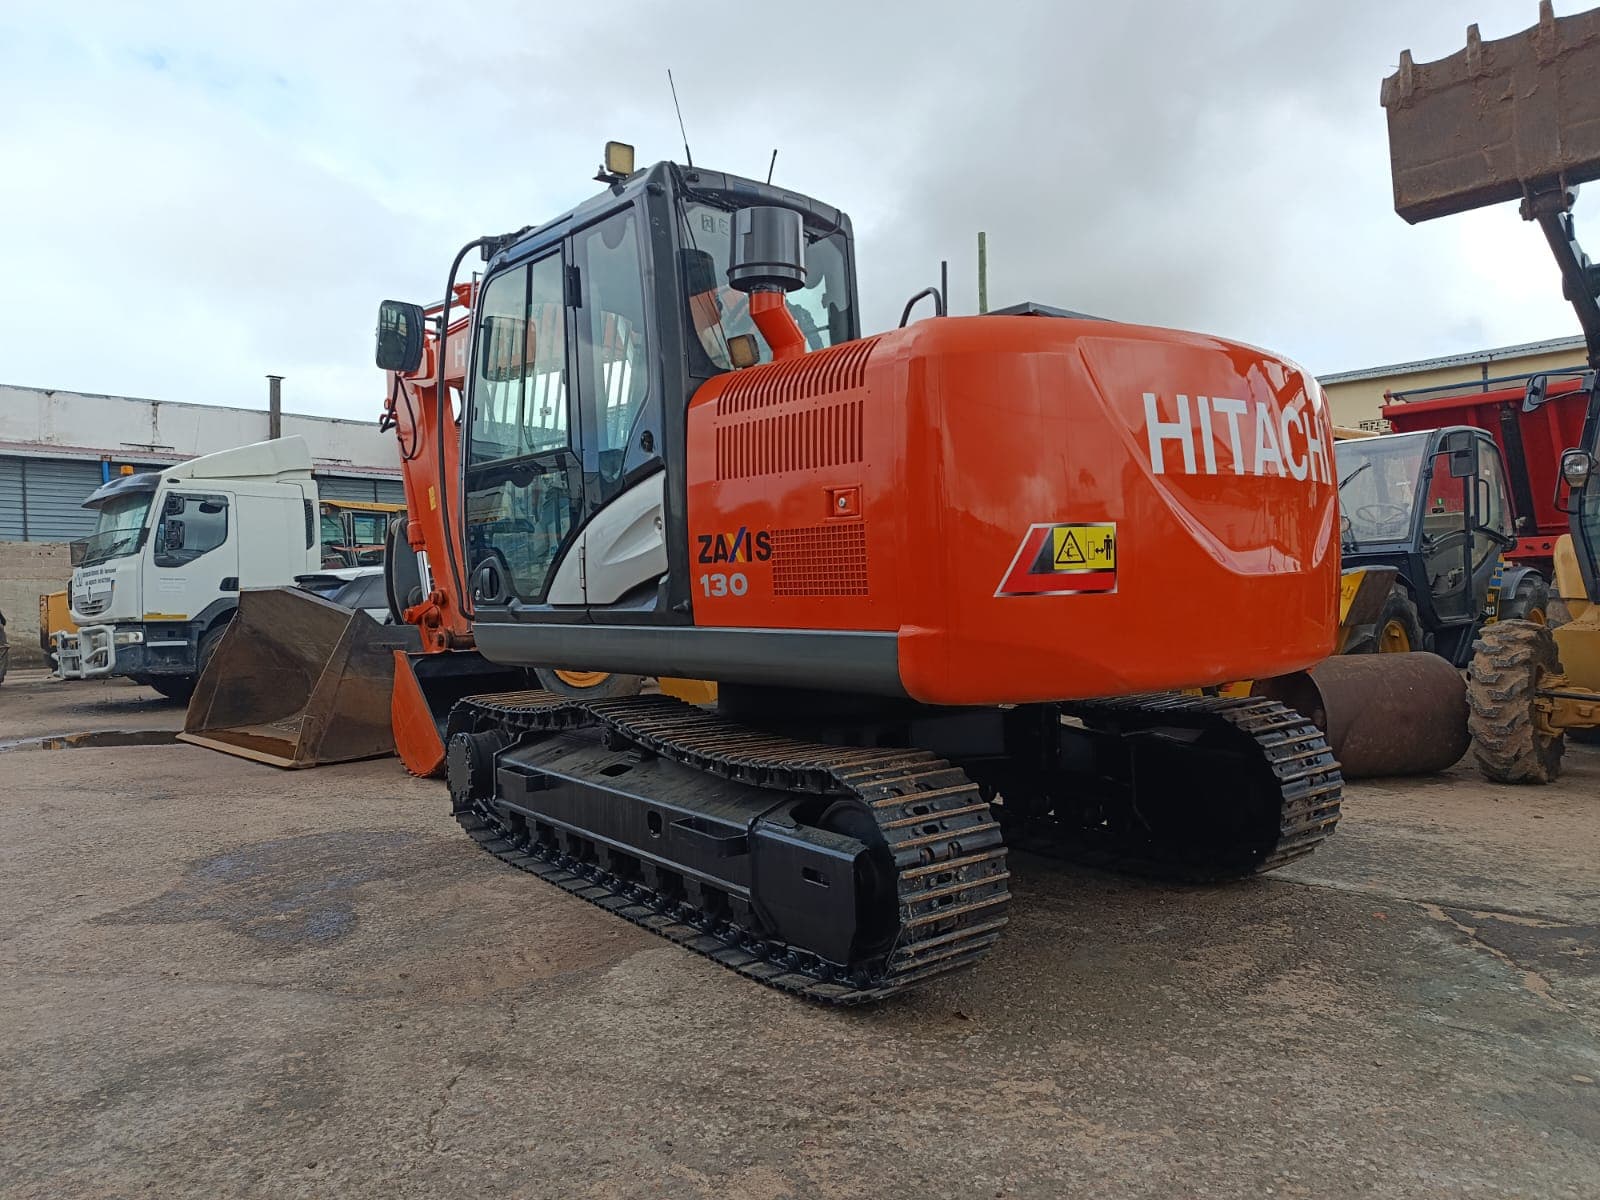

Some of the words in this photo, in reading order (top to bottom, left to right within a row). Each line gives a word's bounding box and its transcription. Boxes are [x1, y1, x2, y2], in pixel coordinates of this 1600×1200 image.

[1142, 392, 1332, 485] HITACHI
[698, 526, 772, 564] ZAXIS
[700, 573, 748, 597] 130
